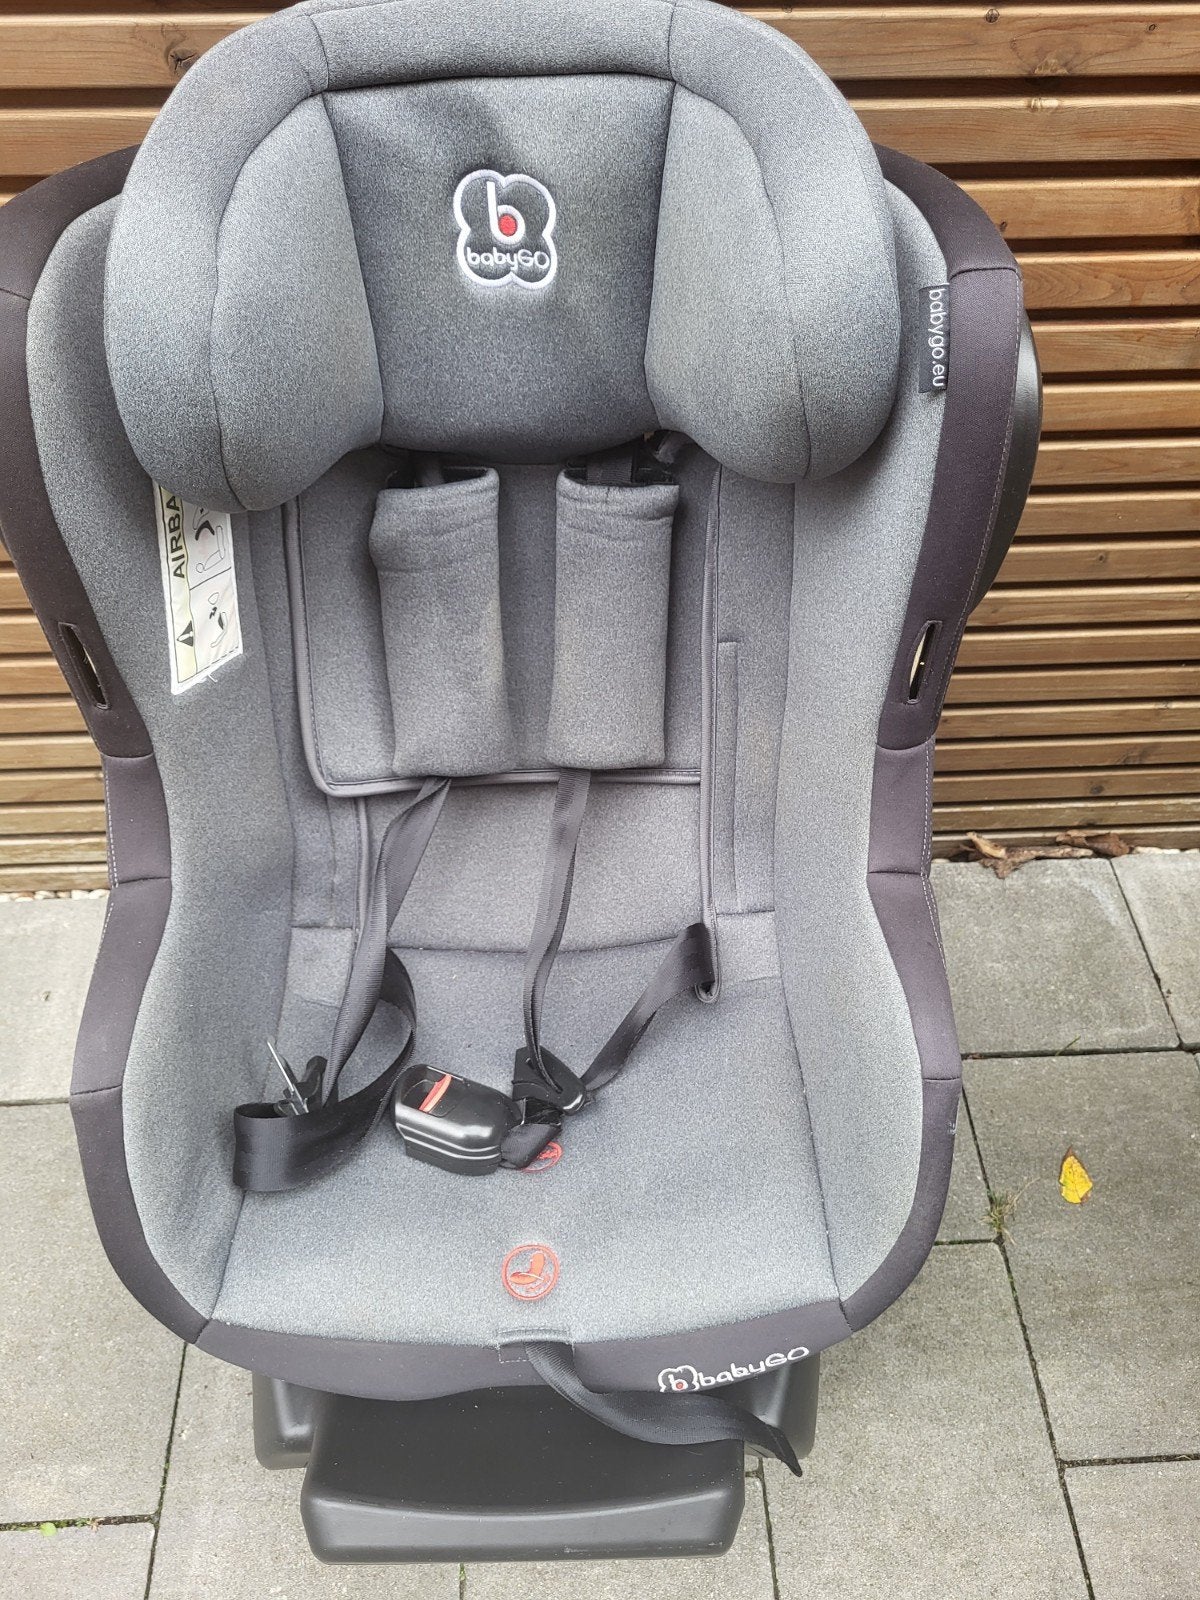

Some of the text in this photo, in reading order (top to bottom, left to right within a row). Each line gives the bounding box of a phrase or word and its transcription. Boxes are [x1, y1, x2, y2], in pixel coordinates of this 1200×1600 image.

[486, 180, 526, 245] b
[466, 246, 550, 271] babyGO
[927, 288, 947, 386] babygo.eu
[165, 495, 186, 579] AIRBA
